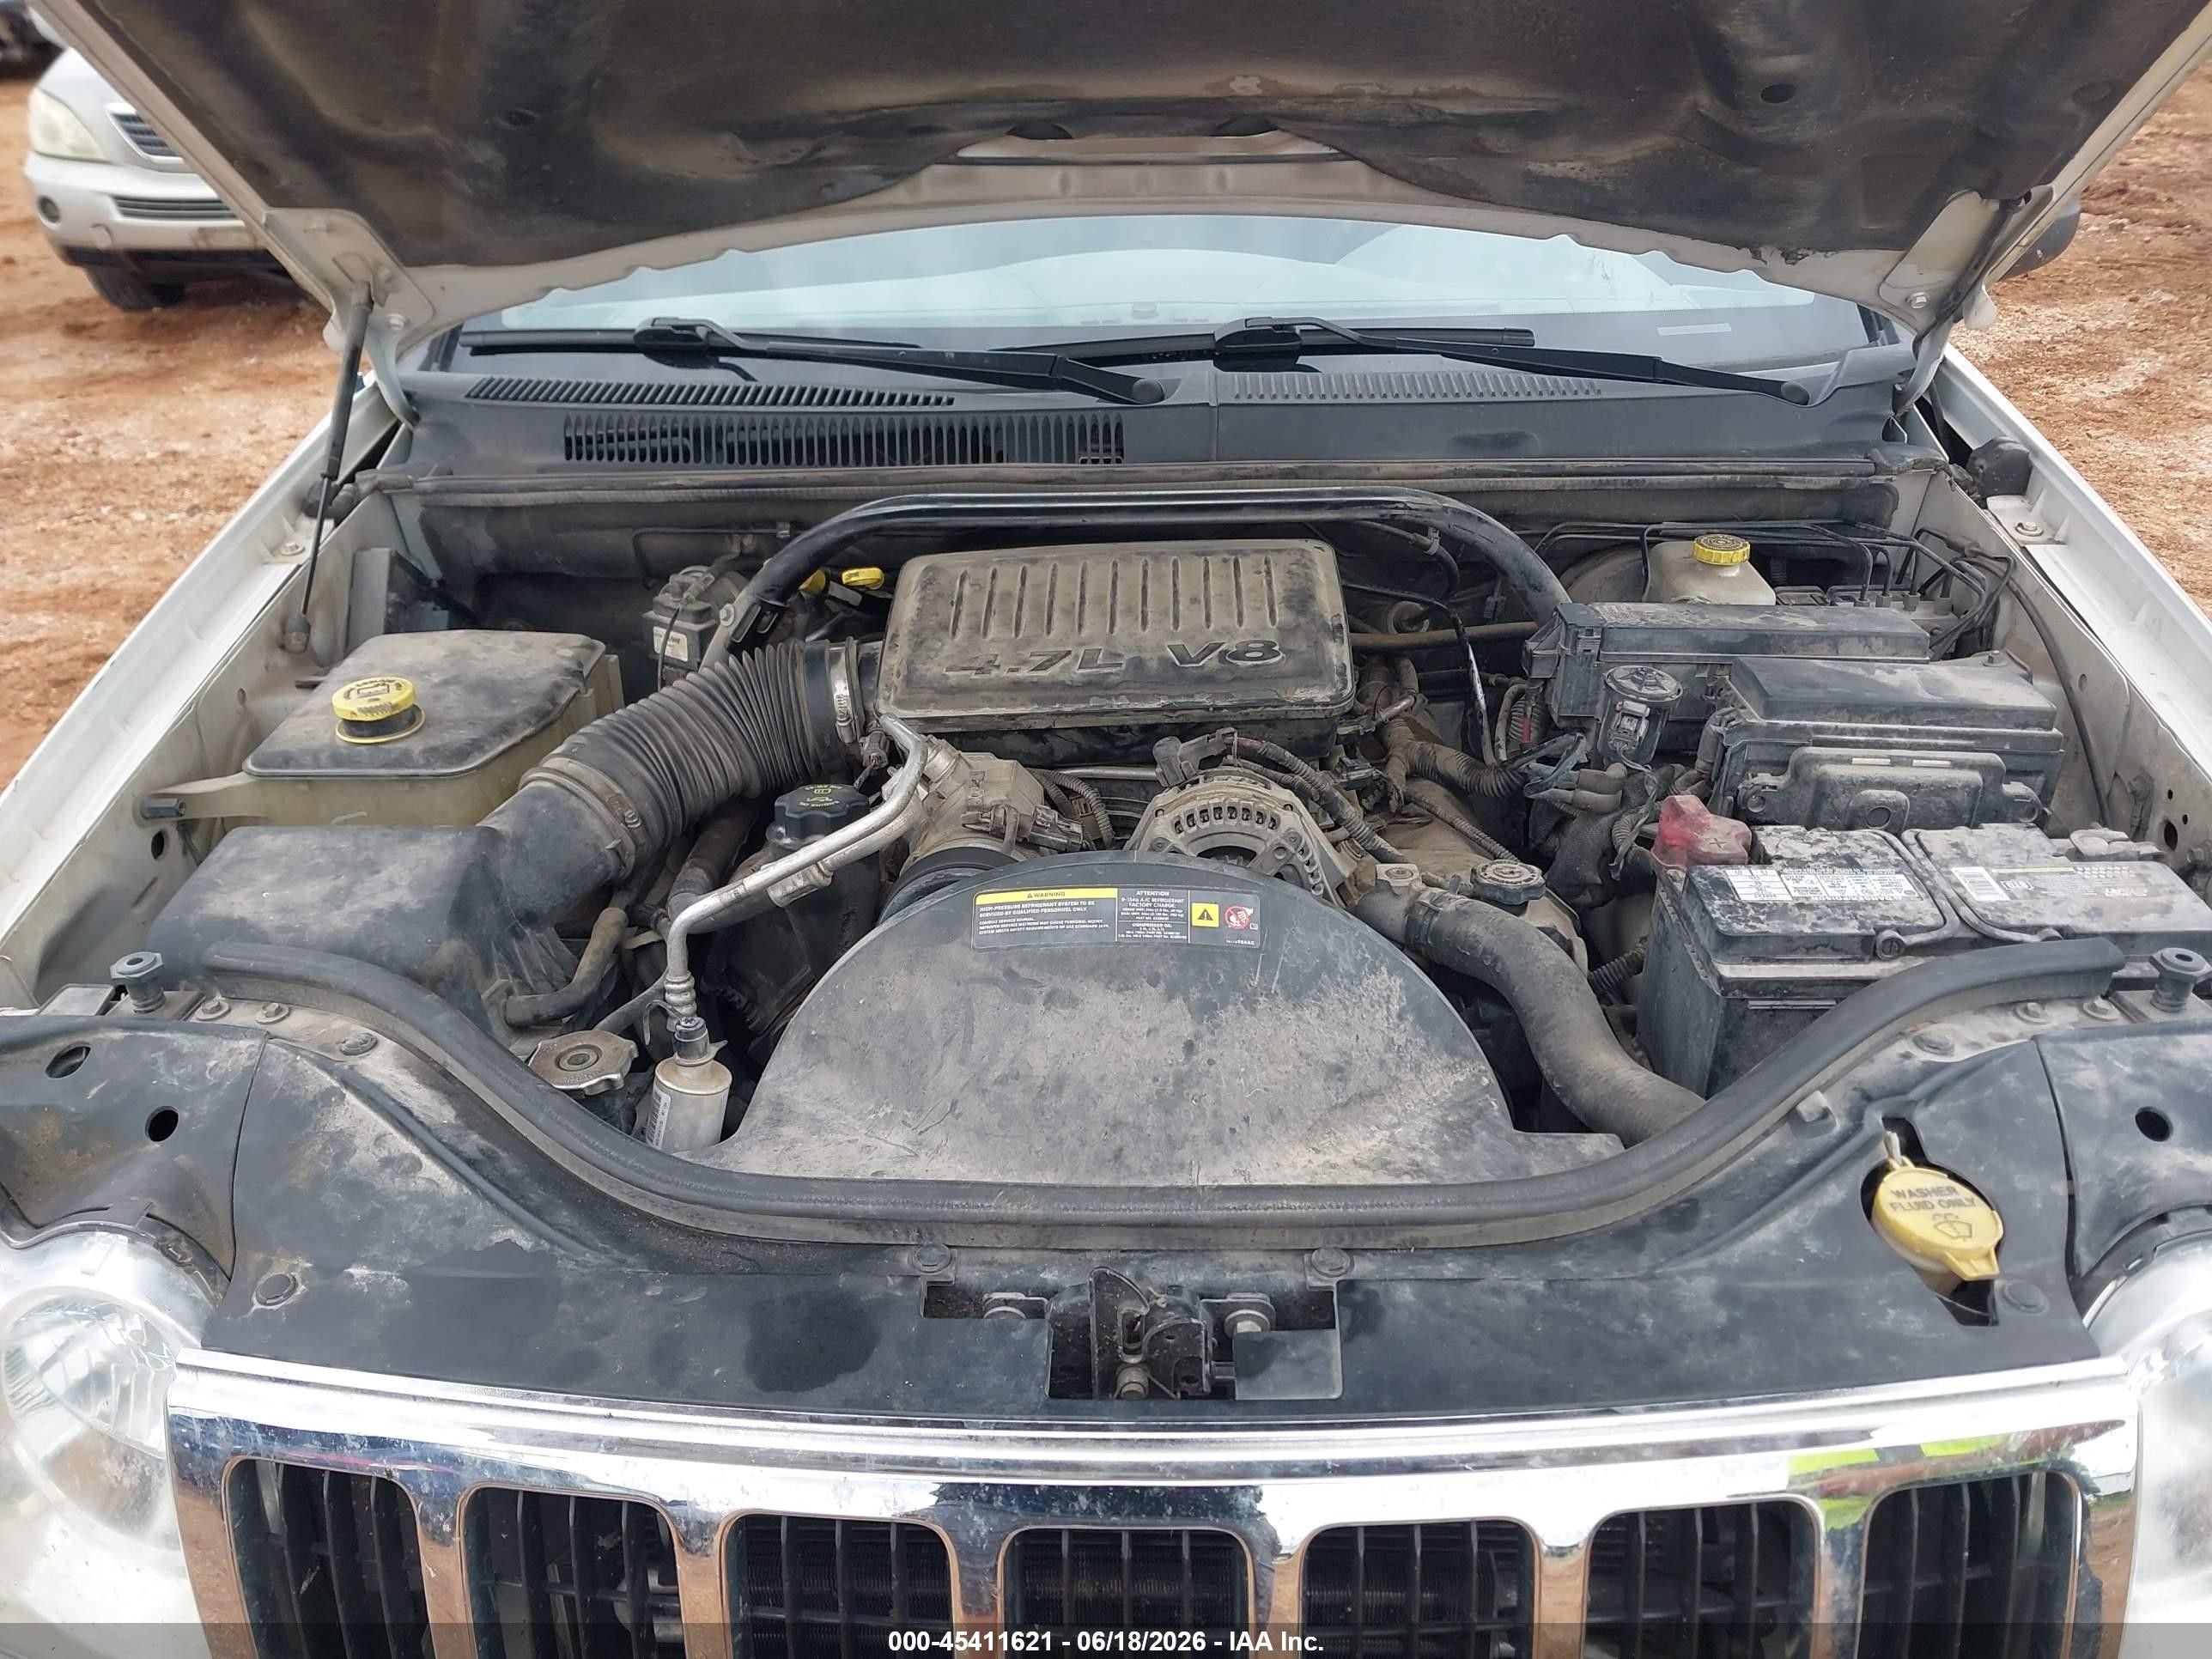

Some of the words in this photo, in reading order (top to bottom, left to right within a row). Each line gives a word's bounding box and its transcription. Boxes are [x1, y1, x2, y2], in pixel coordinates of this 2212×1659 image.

[945, 647, 1123, 679] 4.7L
[1166, 639, 1286, 668] V8
[1891, 1186, 1959, 1199] WASHER
[1890, 1200, 1936, 1212] FLUID
[1937, 1197, 1977, 1209] ONLY
